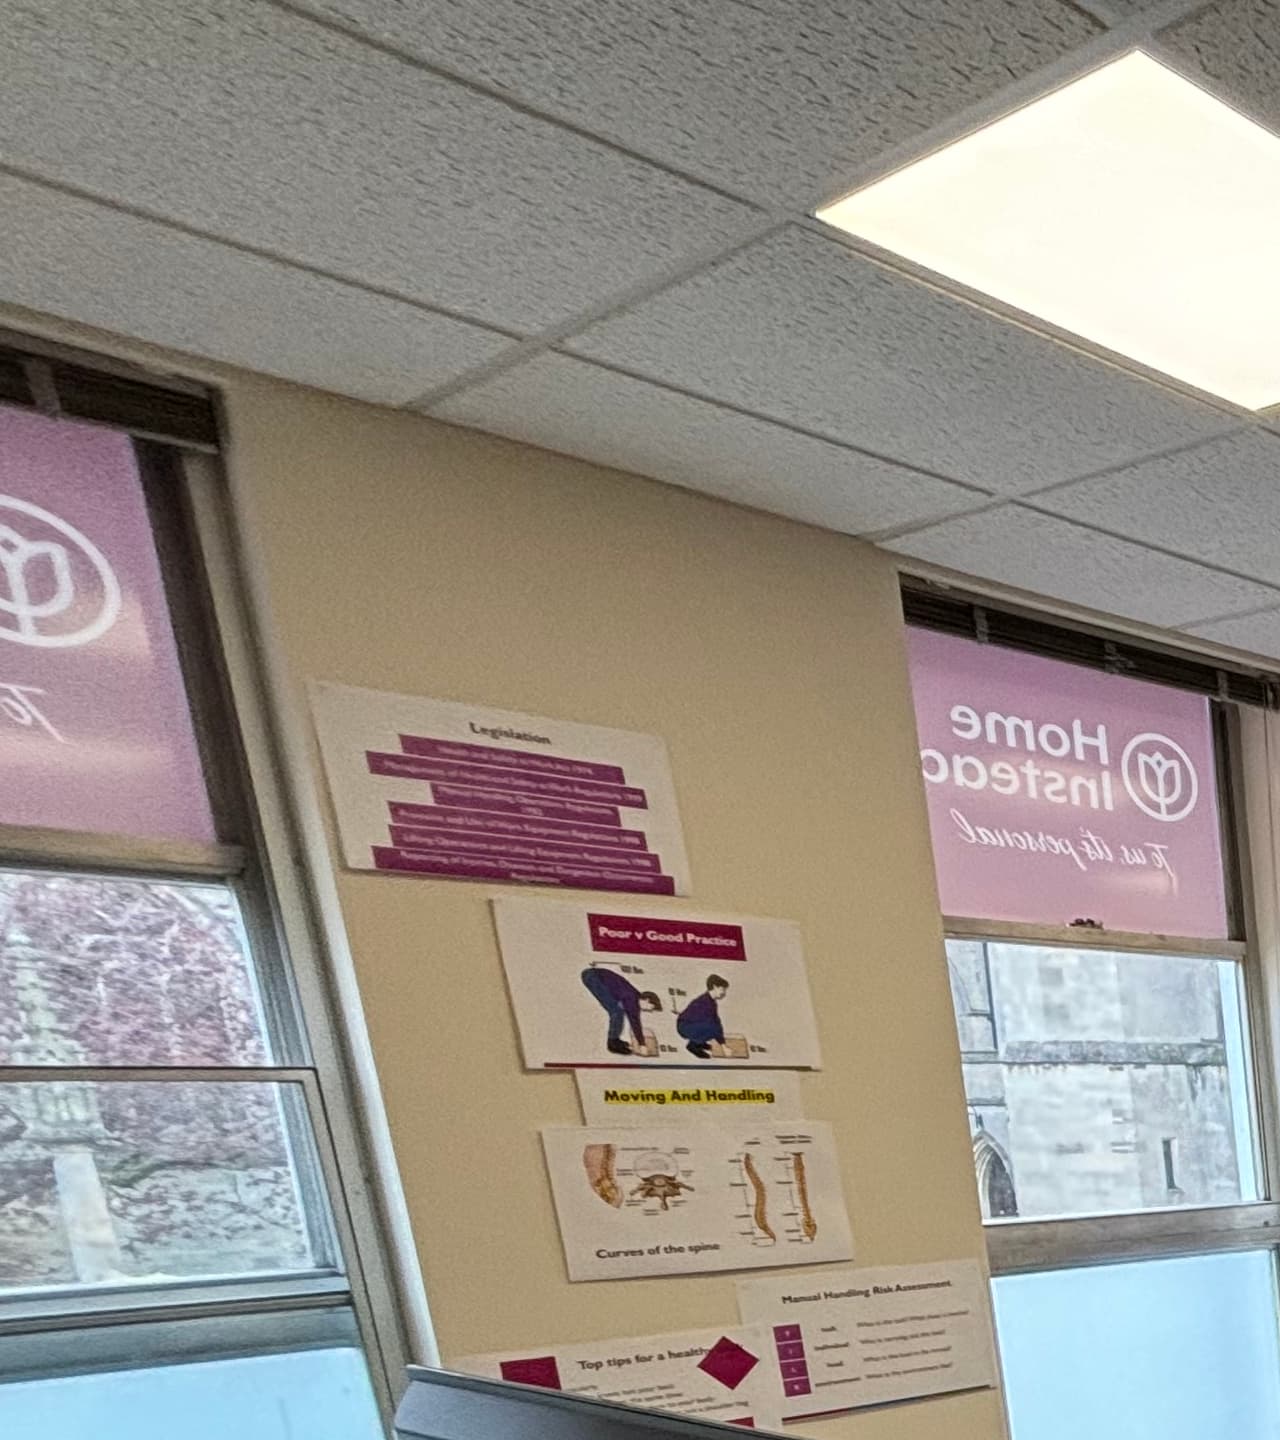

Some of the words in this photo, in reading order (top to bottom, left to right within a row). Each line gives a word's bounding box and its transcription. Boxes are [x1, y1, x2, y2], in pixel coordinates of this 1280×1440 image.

[469, 722, 552, 745] Legislation
[599, 926, 631, 940] Poor
[635, 932, 645, 940] v
[646, 930, 684, 944] Good
[686, 932, 737, 947] Practice
[604, 1090, 665, 1104] Moving
[670, 1089, 701, 1101] And
[705, 1089, 775, 1104] Handling
[596, 1248, 645, 1259] Curves
[647, 1246, 661, 1255] of
[663, 1244, 685, 1254] the
[688, 1242, 720, 1255] spine
[782, 1294, 821, 1304] Manual
[824, 1288, 870, 1299] Handling
[872, 1285, 894, 1295] Risk
[895, 1280, 952, 1292] Assessment
[579, 1360, 602, 1371] Top
[607, 1356, 632, 1368] tips
[634, 1354, 652, 1363] for
[657, 1353, 665, 1361] a
